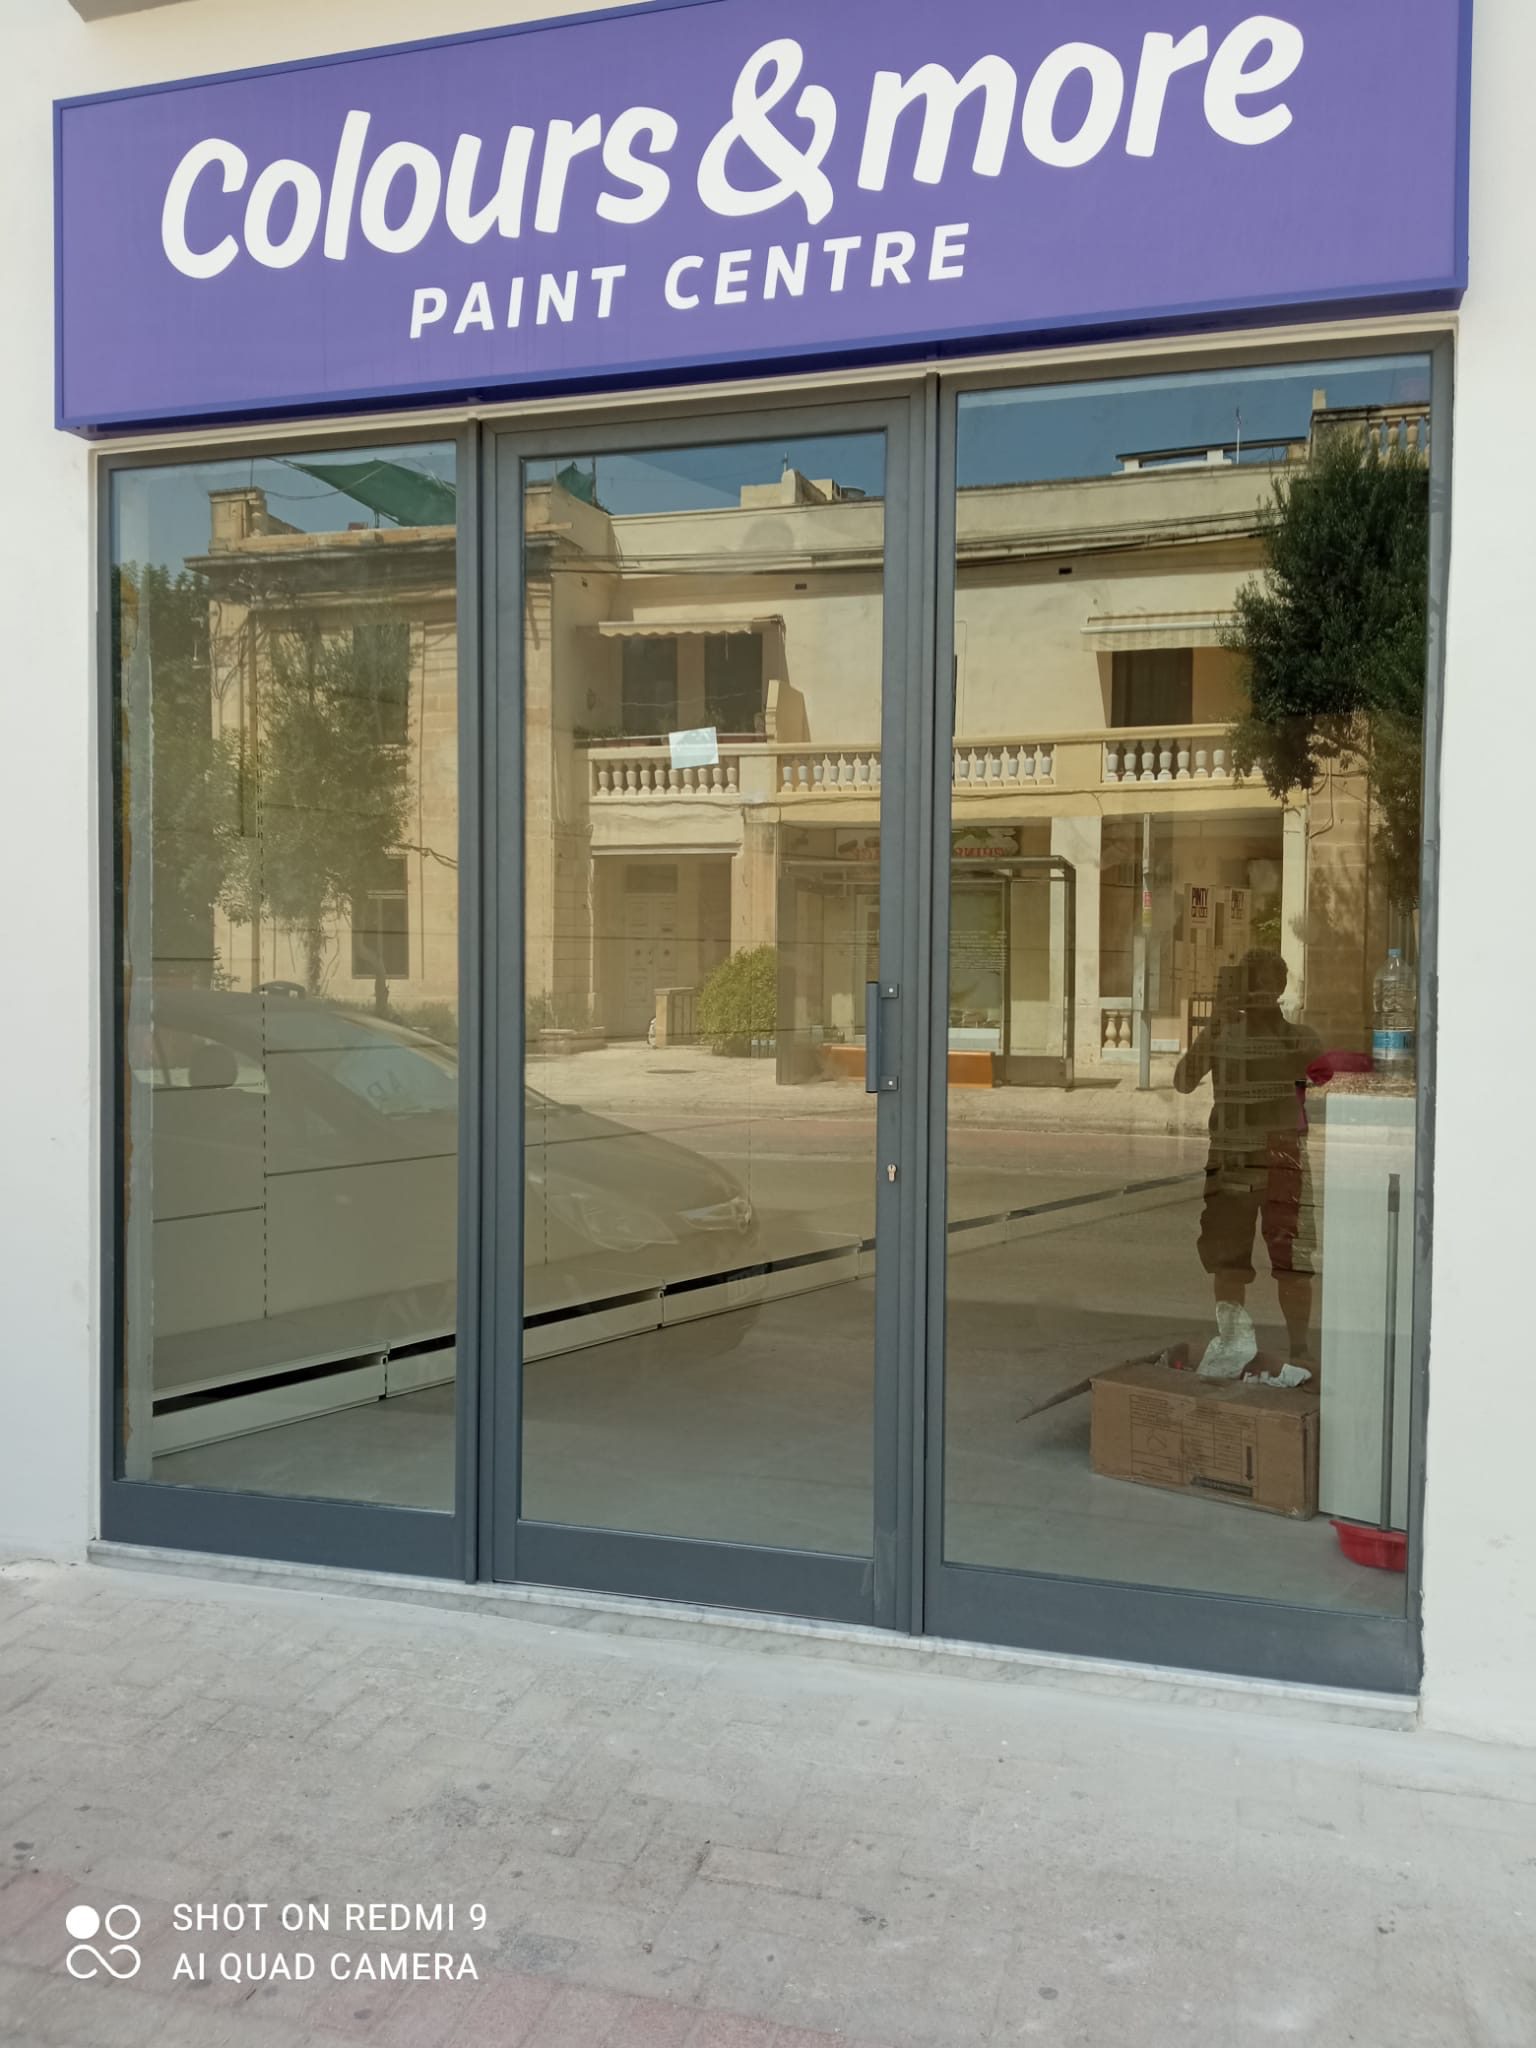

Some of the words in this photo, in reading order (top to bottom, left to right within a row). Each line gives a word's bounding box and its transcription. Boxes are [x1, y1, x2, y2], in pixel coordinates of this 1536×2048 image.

[161, 106, 679, 279] Colours
[697, 38, 837, 225] &
[857, 15, 1304, 191] more
[409, 264, 627, 340] PAINT
[663, 222, 970, 311] CENTRE
